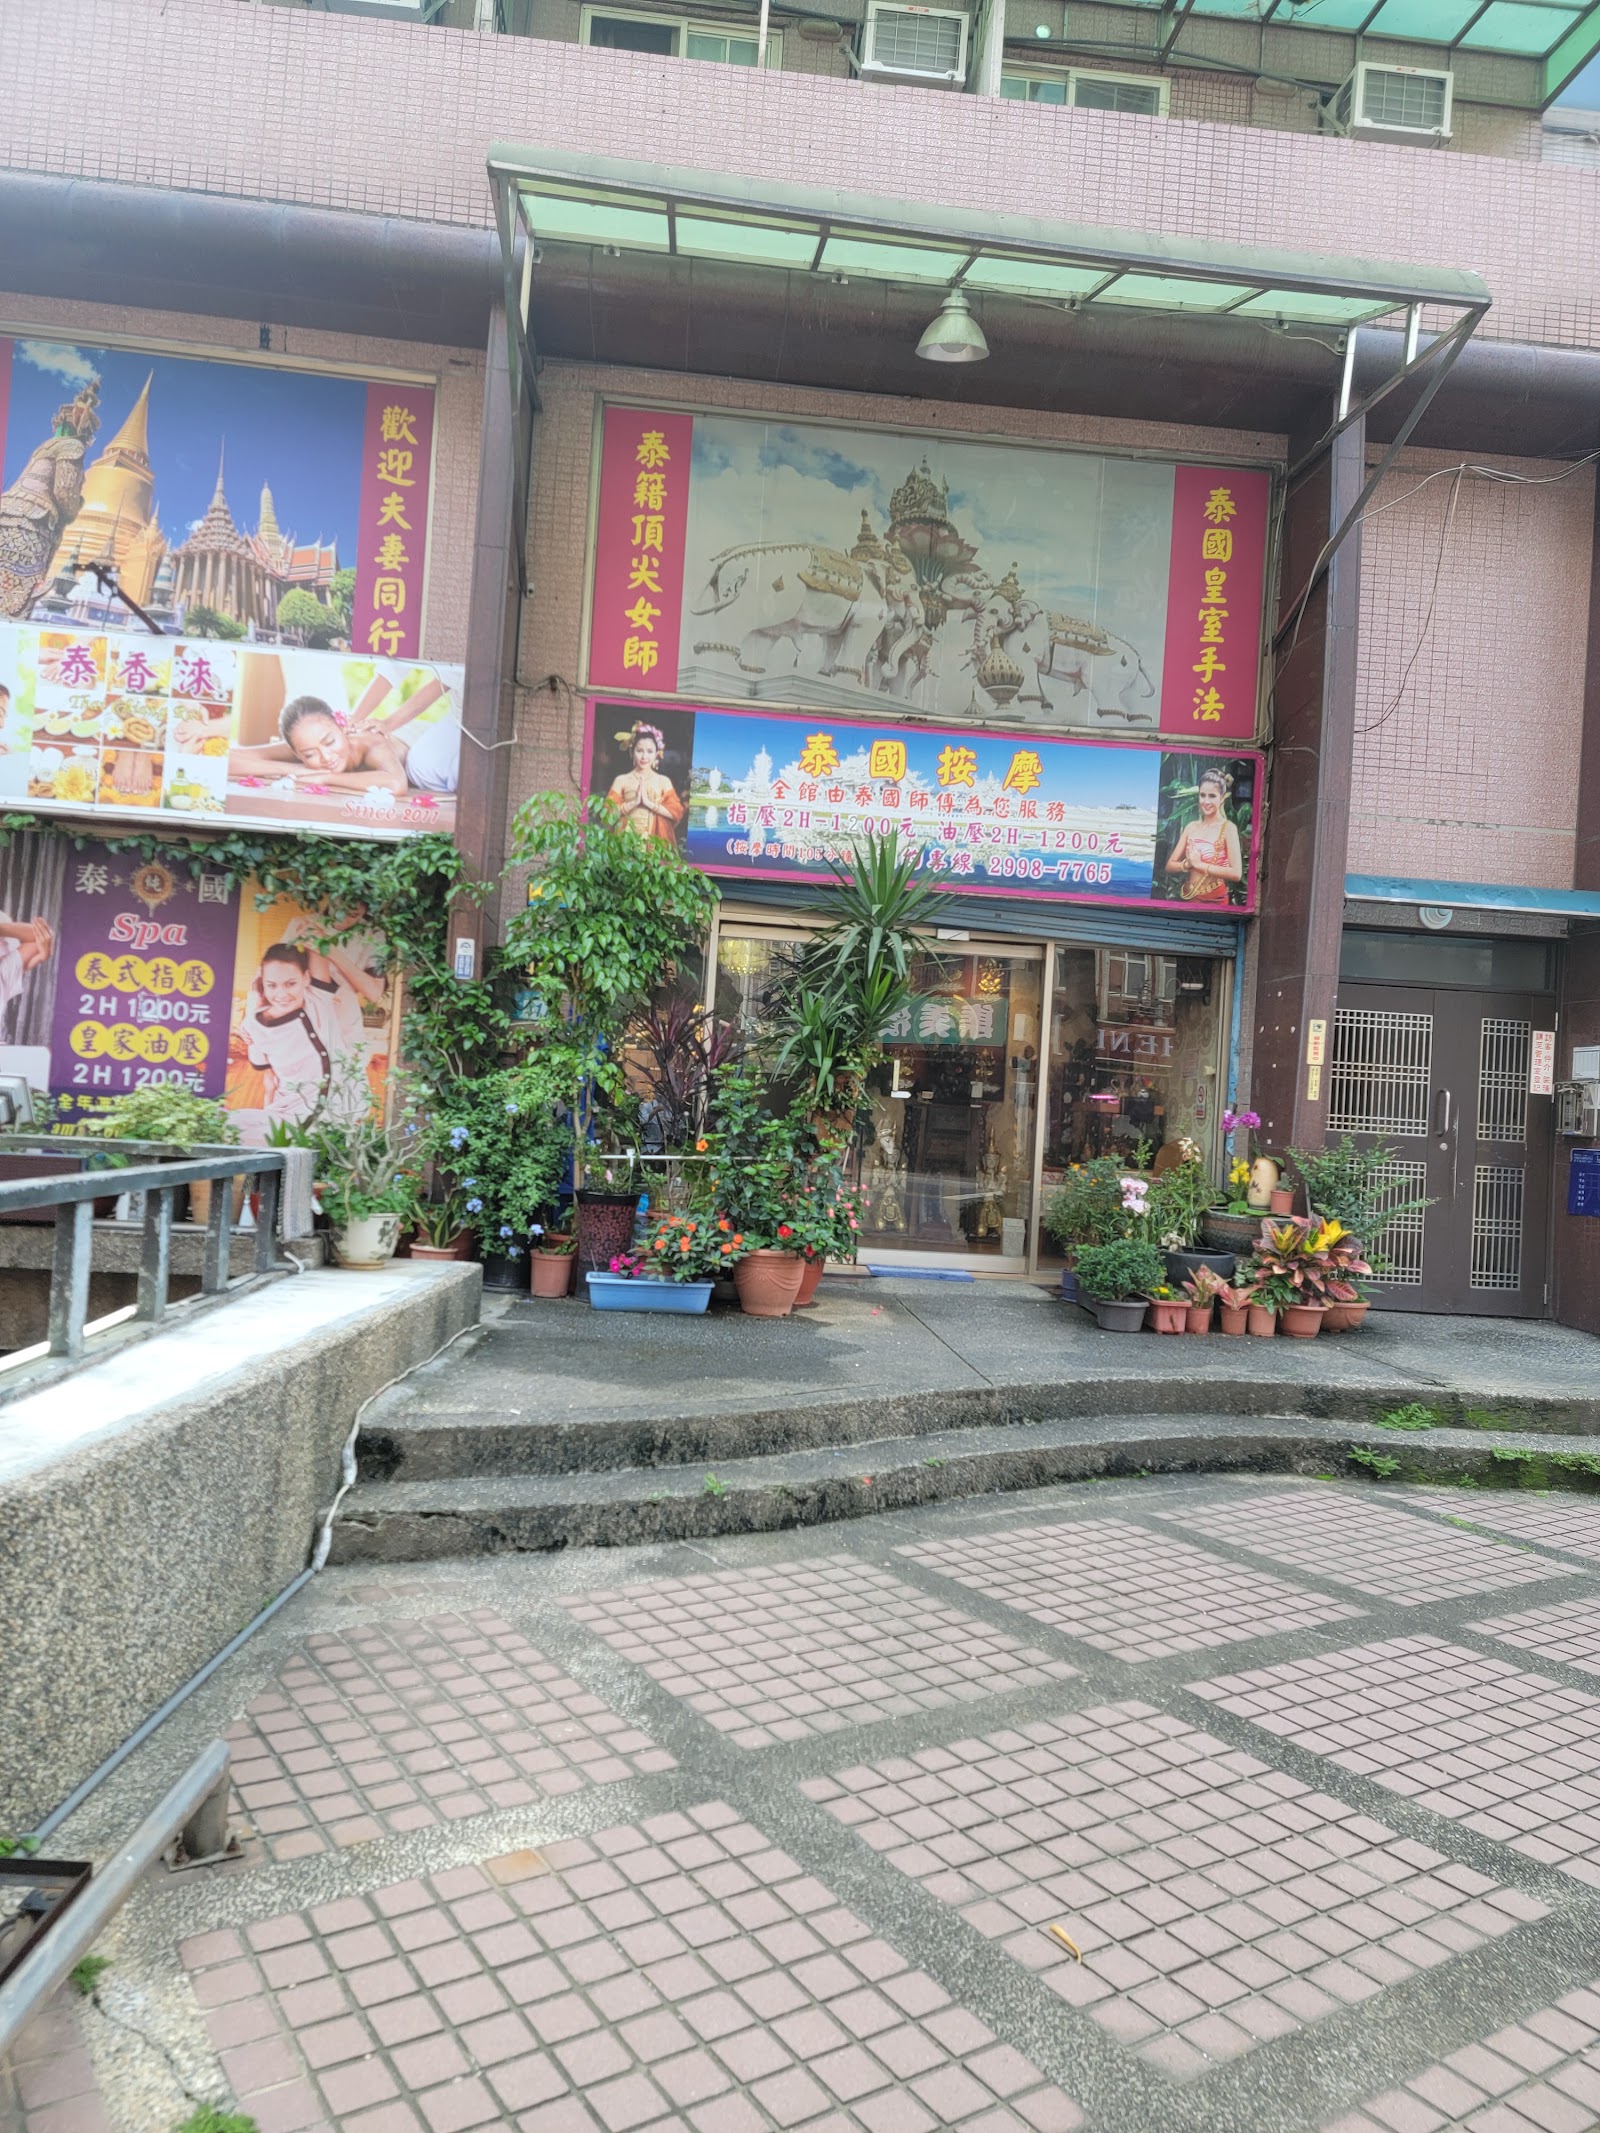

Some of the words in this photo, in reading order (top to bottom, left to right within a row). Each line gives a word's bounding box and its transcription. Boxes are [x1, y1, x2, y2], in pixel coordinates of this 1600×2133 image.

[367, 405, 419, 656] 歡迎夫妻同行
[623, 429, 671, 676] 泰籍頂尖女師
[1192, 486, 1238, 722] 泰國皇室手法
[798, 731, 1043, 794] 泰國按摩
[342, 800, 396, 821] Since
[401, 807, 439, 824] 2011
[988, 855, 1112, 884] 2998-7765
[109, 912, 187, 950] Spa
[83, 957, 208, 992] 泰式指壓
[79, 1025, 202, 1060] 皇家油壓
